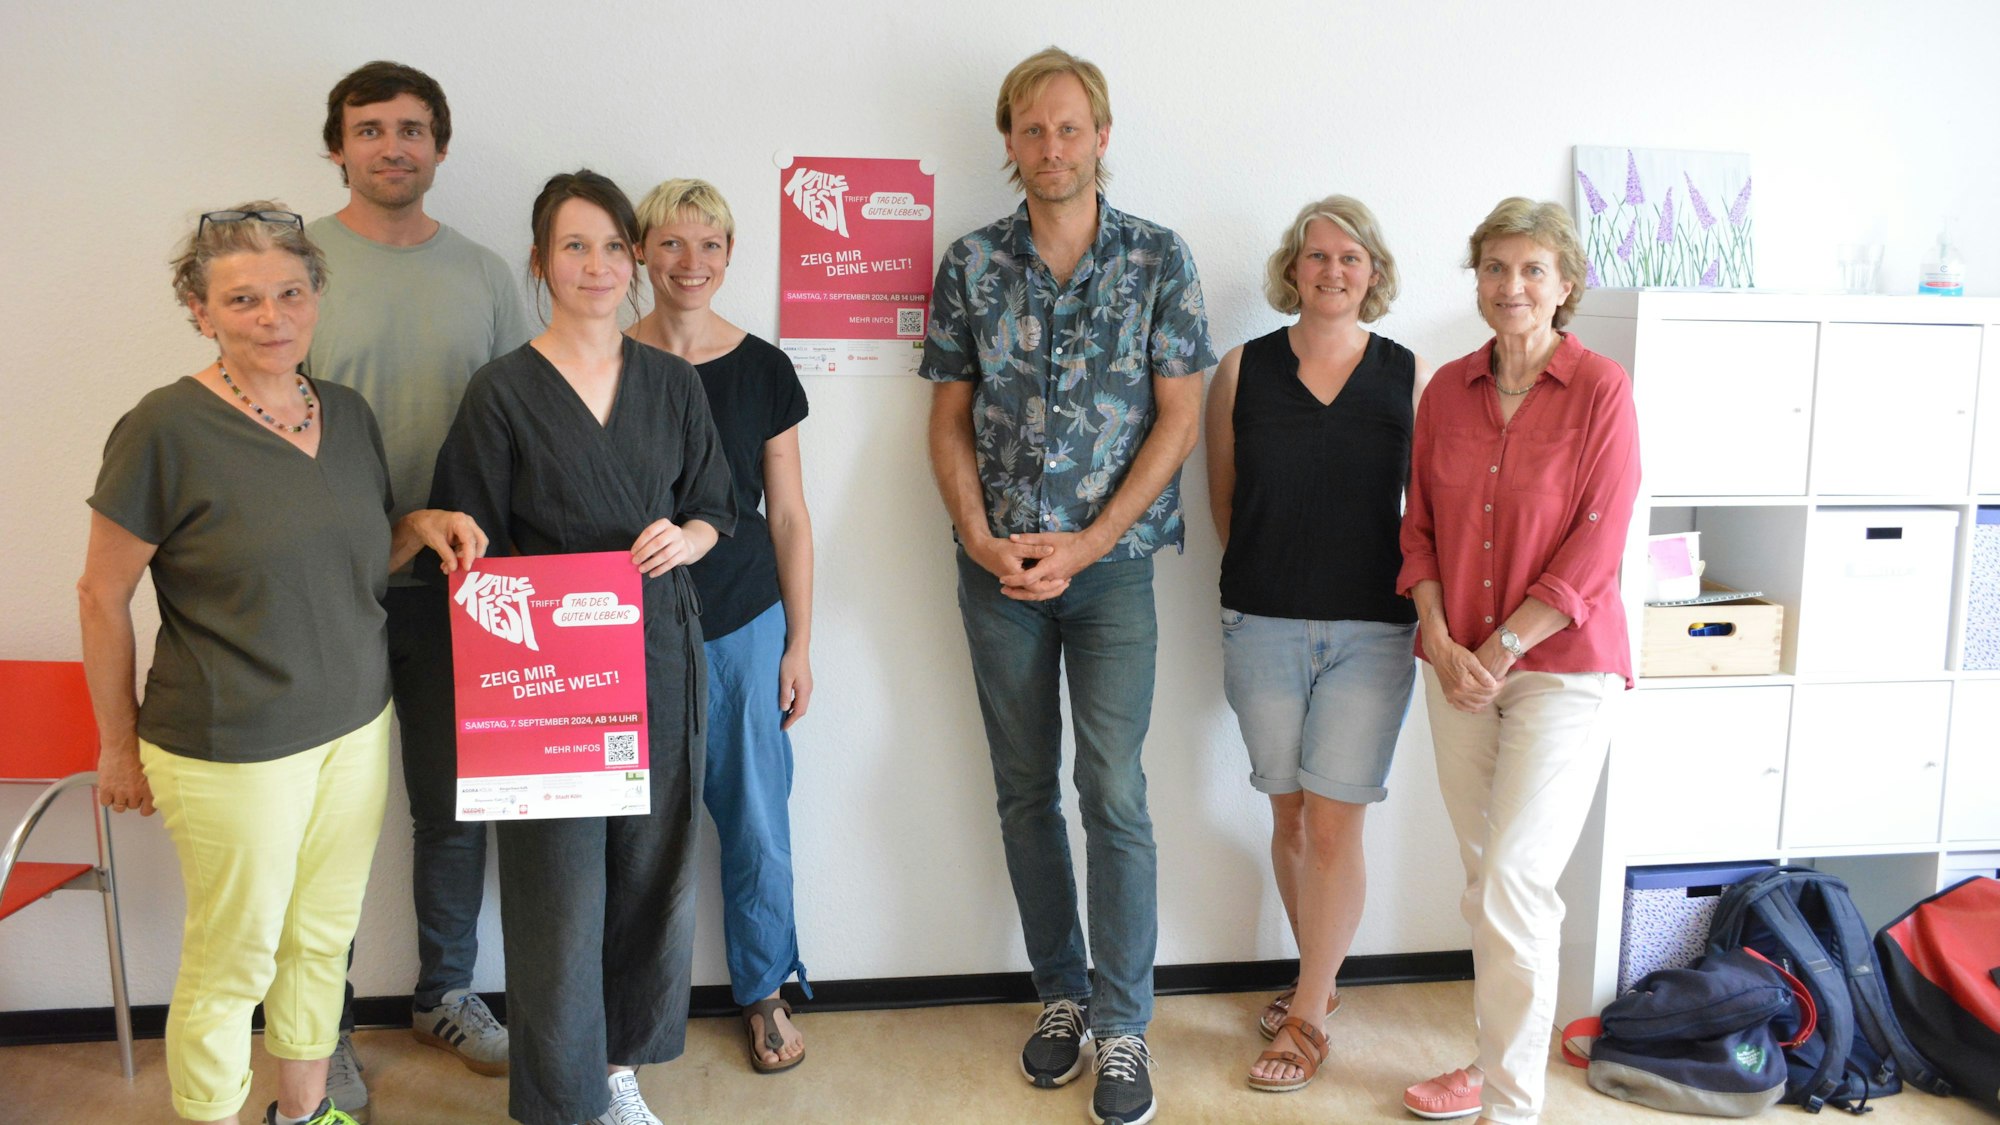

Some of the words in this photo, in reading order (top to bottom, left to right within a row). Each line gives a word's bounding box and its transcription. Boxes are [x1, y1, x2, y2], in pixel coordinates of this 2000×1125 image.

[844, 195, 869, 203] TRIFFT
[877, 196, 890, 204] TAG
[891, 196, 908, 204] DES
[803, 185, 850, 239] FEST
[868, 207, 893, 216] GUTEN
[894, 208, 924, 217] LEBENS
[800, 252, 833, 266] ZEIG
[836, 249, 862, 263] MIR
[826, 262, 869, 277] DEINE
[871, 258, 912, 273] WELT!
[787, 292, 822, 301] SAMSTAG,
[829, 293, 871, 301] SEPTEMBER
[872, 293, 889, 302] 2024,
[849, 316, 871, 324] MEHR
[872, 316, 894, 324] INFOS
[530, 599, 561, 608] TRIFFT
[571, 597, 587, 607] TAG
[589, 596, 610, 607] DES
[479, 588, 540, 652] FEST
[561, 610, 592, 622] GUTEN
[593, 609, 631, 620] LEBENS
[480, 669, 520, 689] ZEIG
[523, 664, 557, 682] MIR
[512, 679, 566, 700] DEINE
[568, 670, 620, 691] WELT!
[465, 719, 509, 730] SAMSTAG,
[510, 719, 517, 728] 7.
[518, 717, 570, 728] SEPTEMBER
[570, 716, 594, 726] 2024,
[594, 715, 607, 724] AB
[608, 714, 618, 723] 14
[618, 714, 638, 723] UHR
[544, 745, 571, 755] MEHR
[573, 744, 601, 753] INFOS
